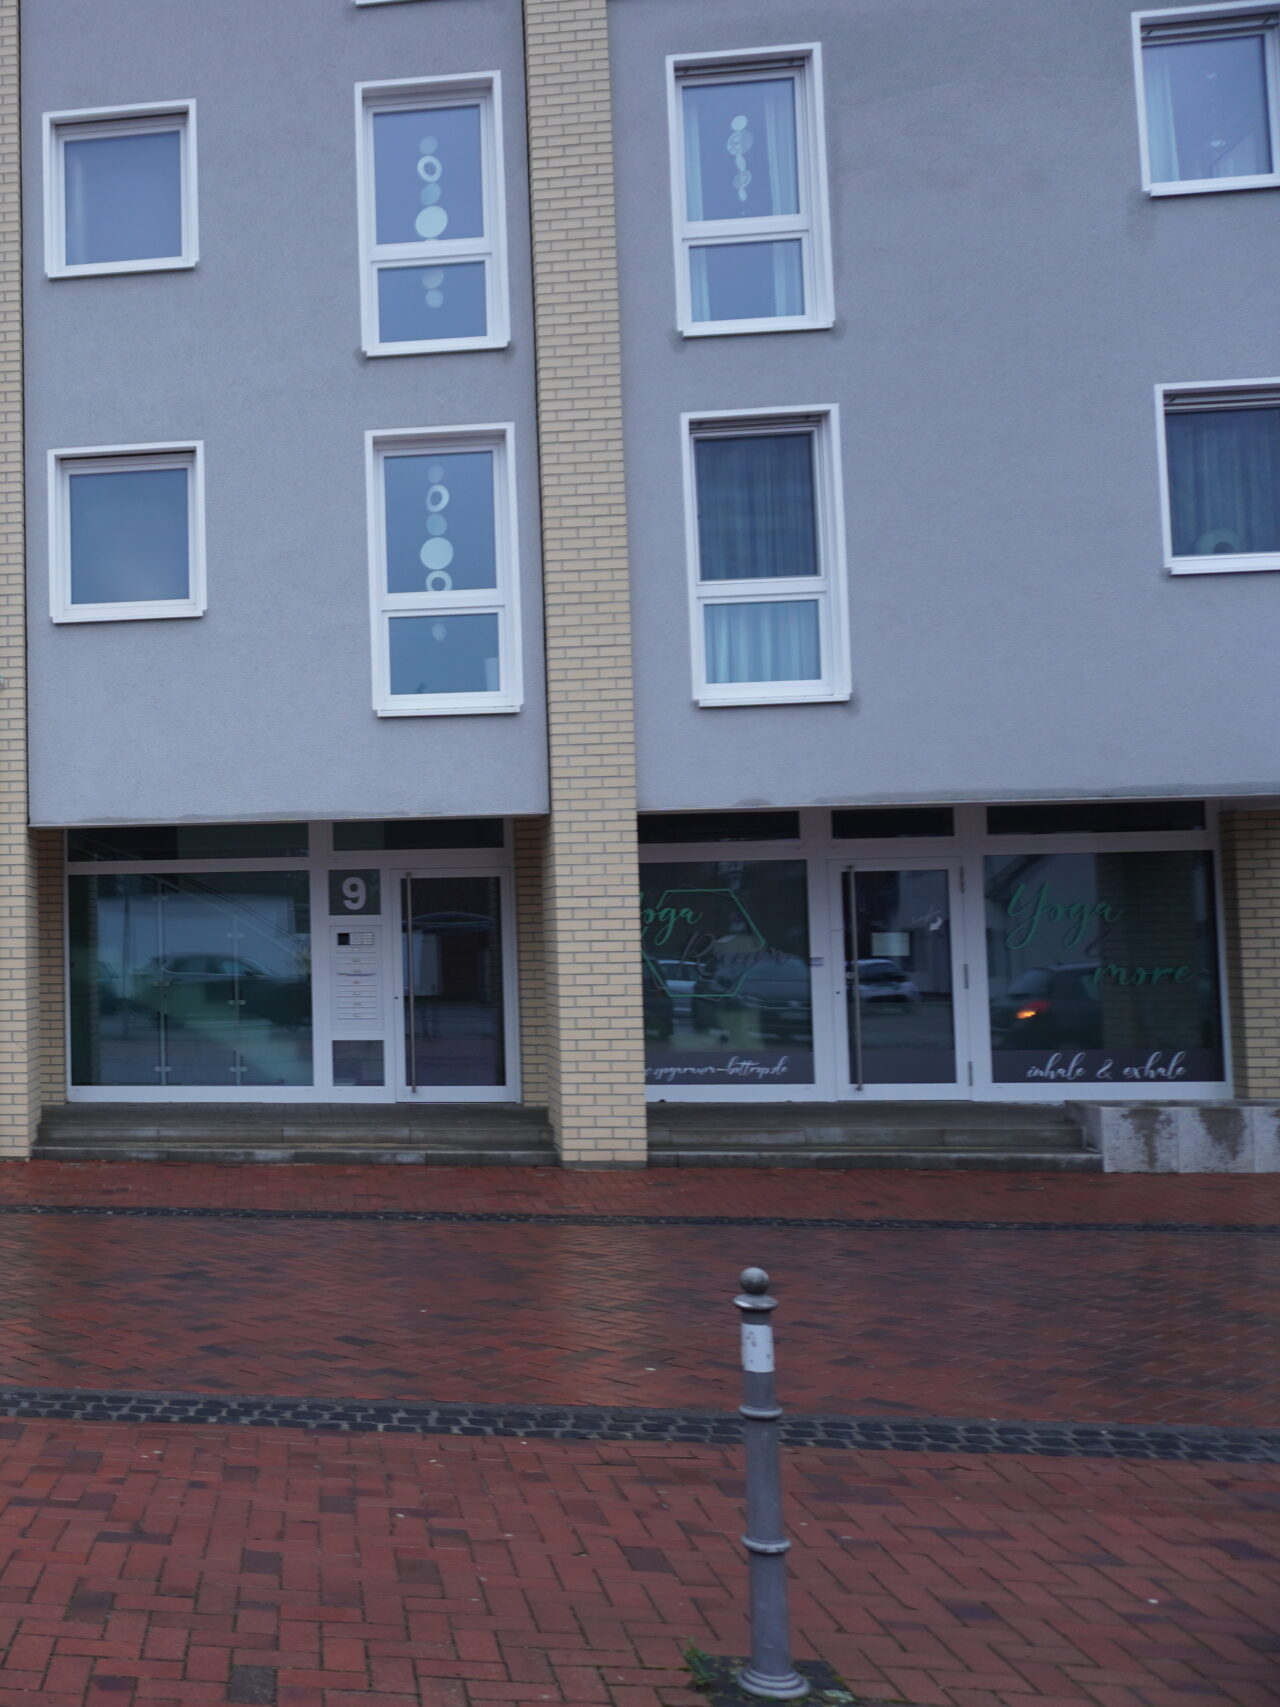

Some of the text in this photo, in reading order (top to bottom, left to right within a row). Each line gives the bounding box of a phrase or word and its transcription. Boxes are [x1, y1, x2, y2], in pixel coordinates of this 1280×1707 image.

[342, 876, 367, 911] 9
[640, 891, 703, 946] oga
[1006, 882, 1121, 950] Yoga
[1092, 962, 1196, 986] more
[1026, 1051, 1187, 1080] inhale & exhale
